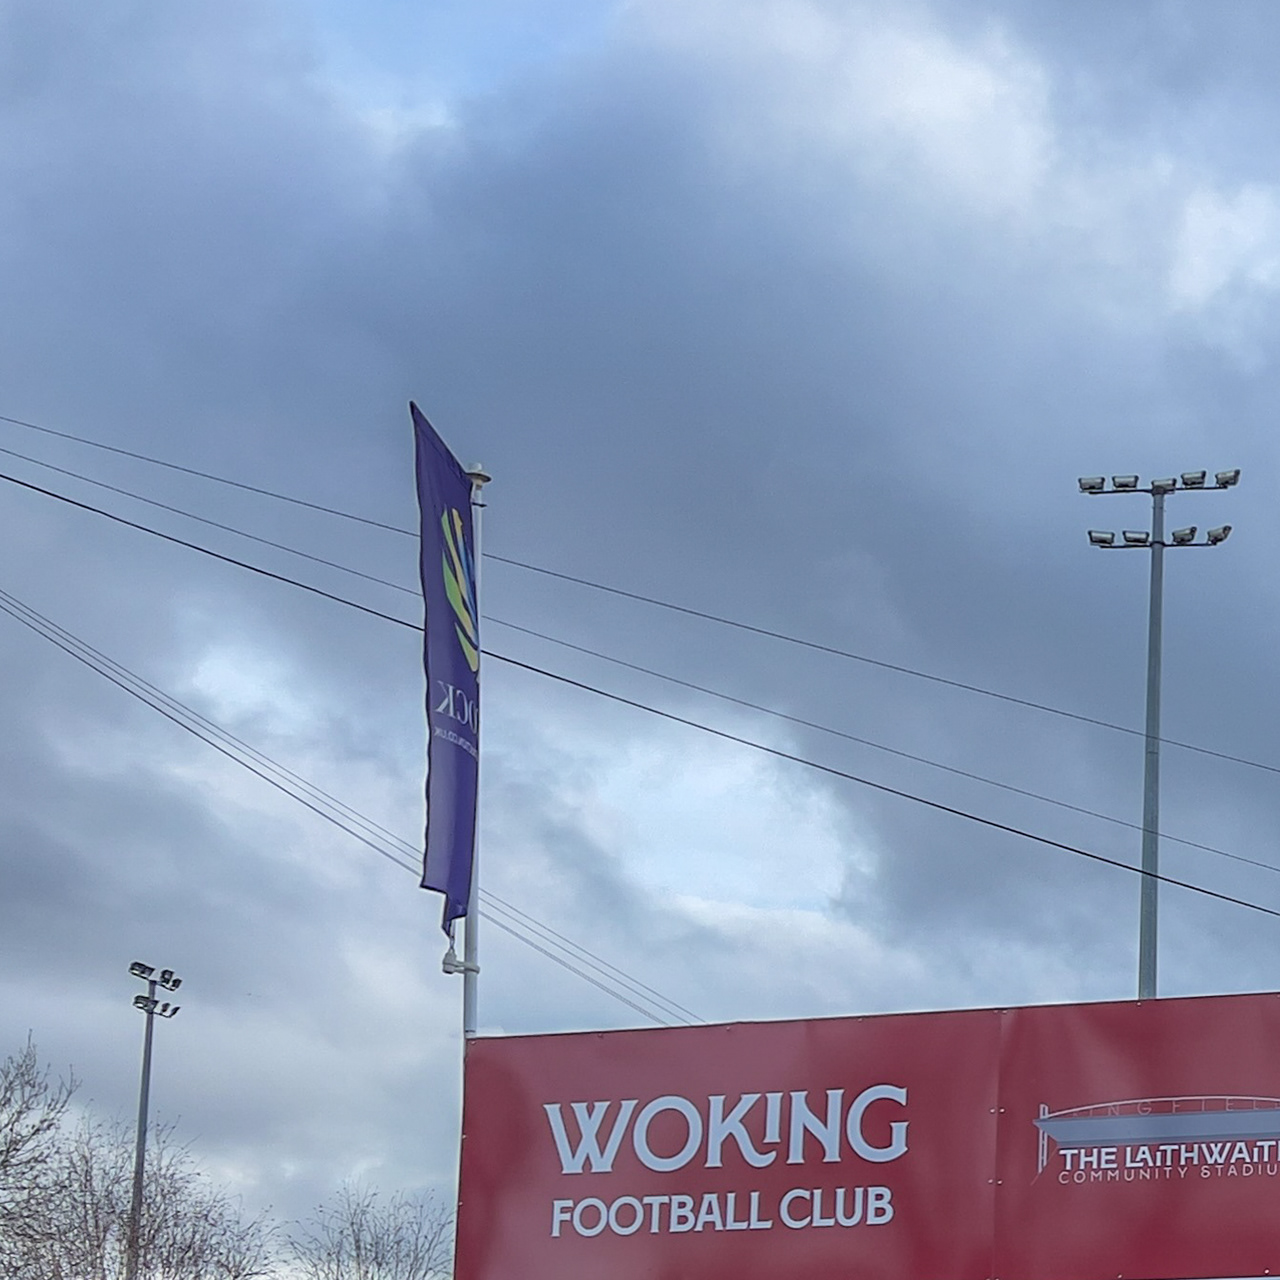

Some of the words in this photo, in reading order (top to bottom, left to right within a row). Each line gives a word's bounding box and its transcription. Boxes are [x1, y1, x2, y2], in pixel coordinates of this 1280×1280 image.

[543, 1084, 909, 1174] WOKING
[1058, 1147, 1118, 1171] THE
[1058, 1166, 1188, 1184] COMMUNITY
[551, 1191, 773, 1237] FOOTBALL
[779, 1186, 894, 1230] CLUB
